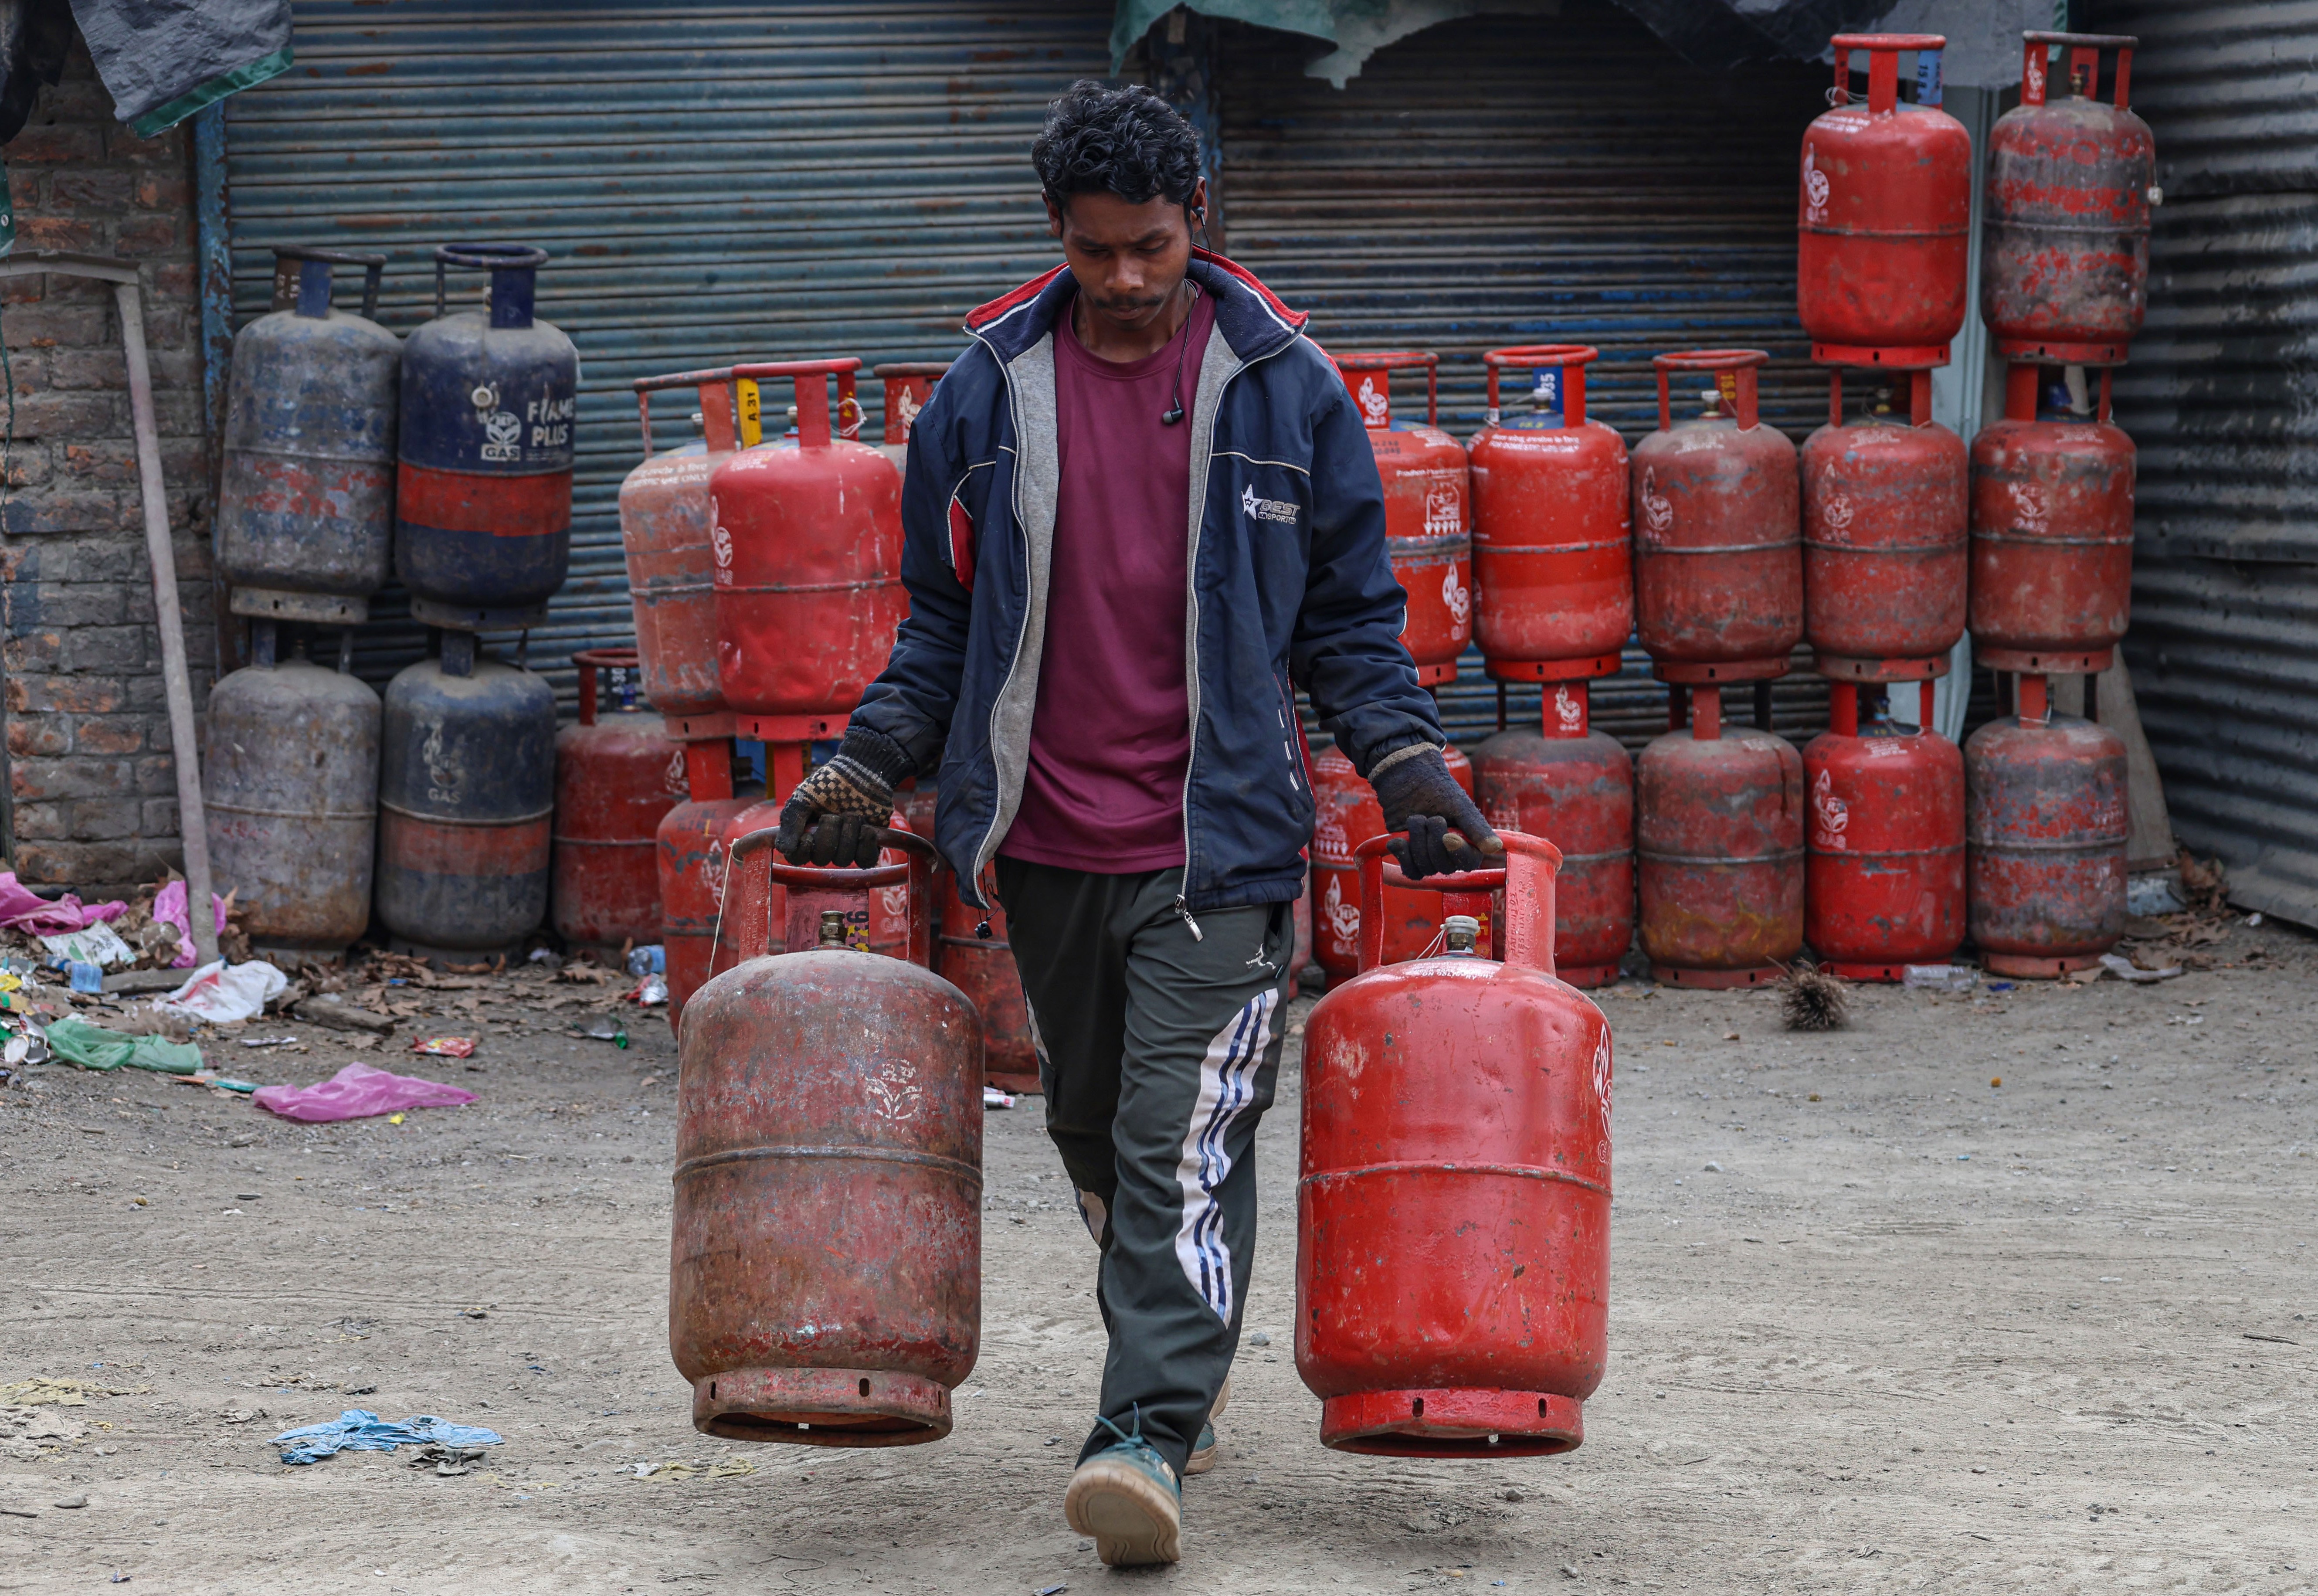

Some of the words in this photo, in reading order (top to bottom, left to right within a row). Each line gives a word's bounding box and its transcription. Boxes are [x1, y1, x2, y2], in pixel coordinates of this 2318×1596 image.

[531, 423, 569, 447] PLUS
[485, 448, 518, 458] GAS
[1259, 499, 1301, 516] BEST
